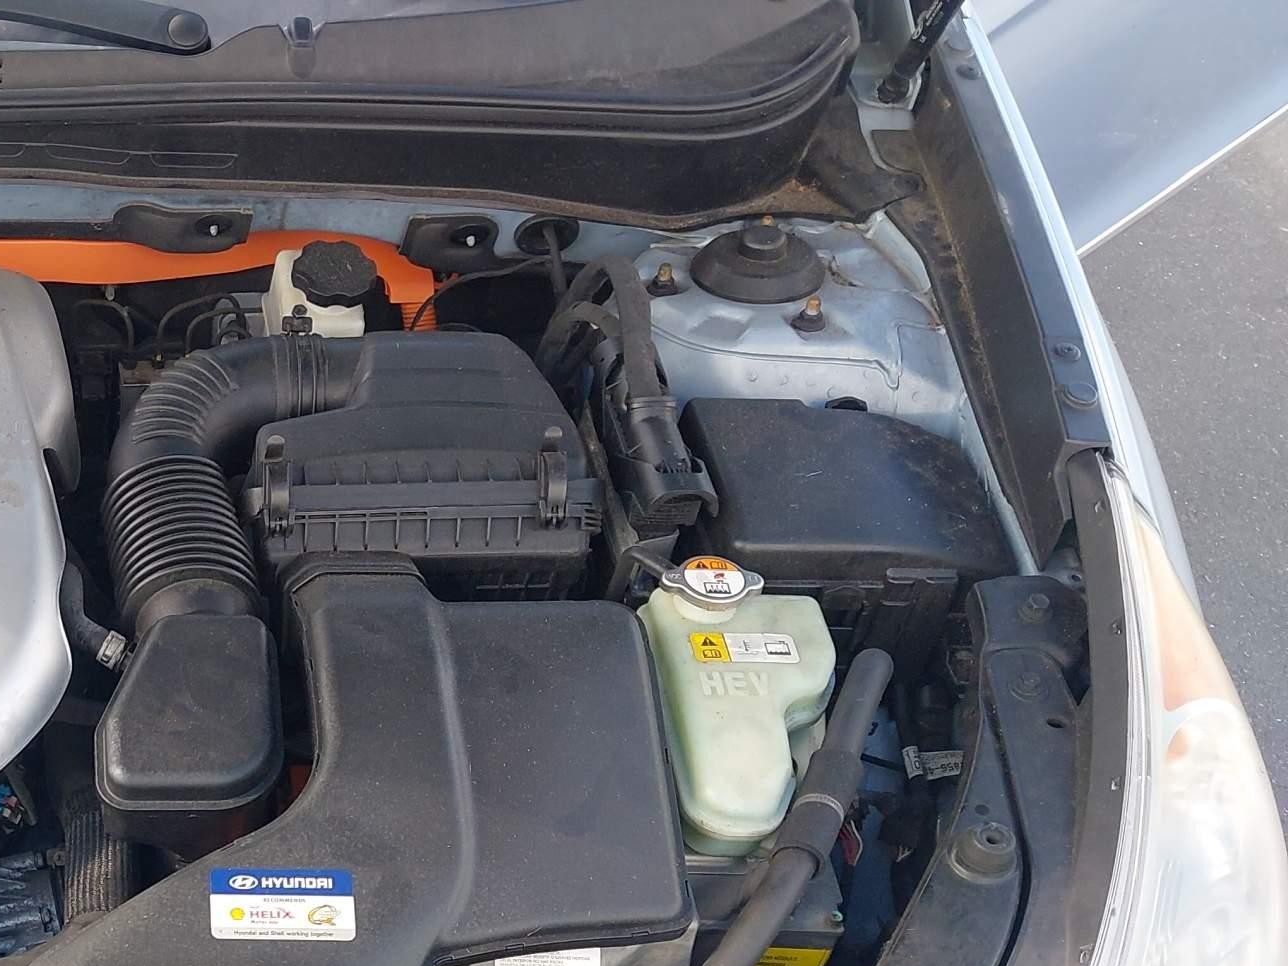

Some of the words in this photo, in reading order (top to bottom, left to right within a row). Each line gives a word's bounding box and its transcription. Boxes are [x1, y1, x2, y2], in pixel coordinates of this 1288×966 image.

[699, 670, 770, 697] HEV
[261, 876, 333, 890] HYUNDAI
[249, 908, 294, 919] HELIX
[233, 929, 258, 937] Hyundai
[270, 929, 285, 937] Shell
[286, 930, 309, 938] working
[310, 930, 334, 938] together
